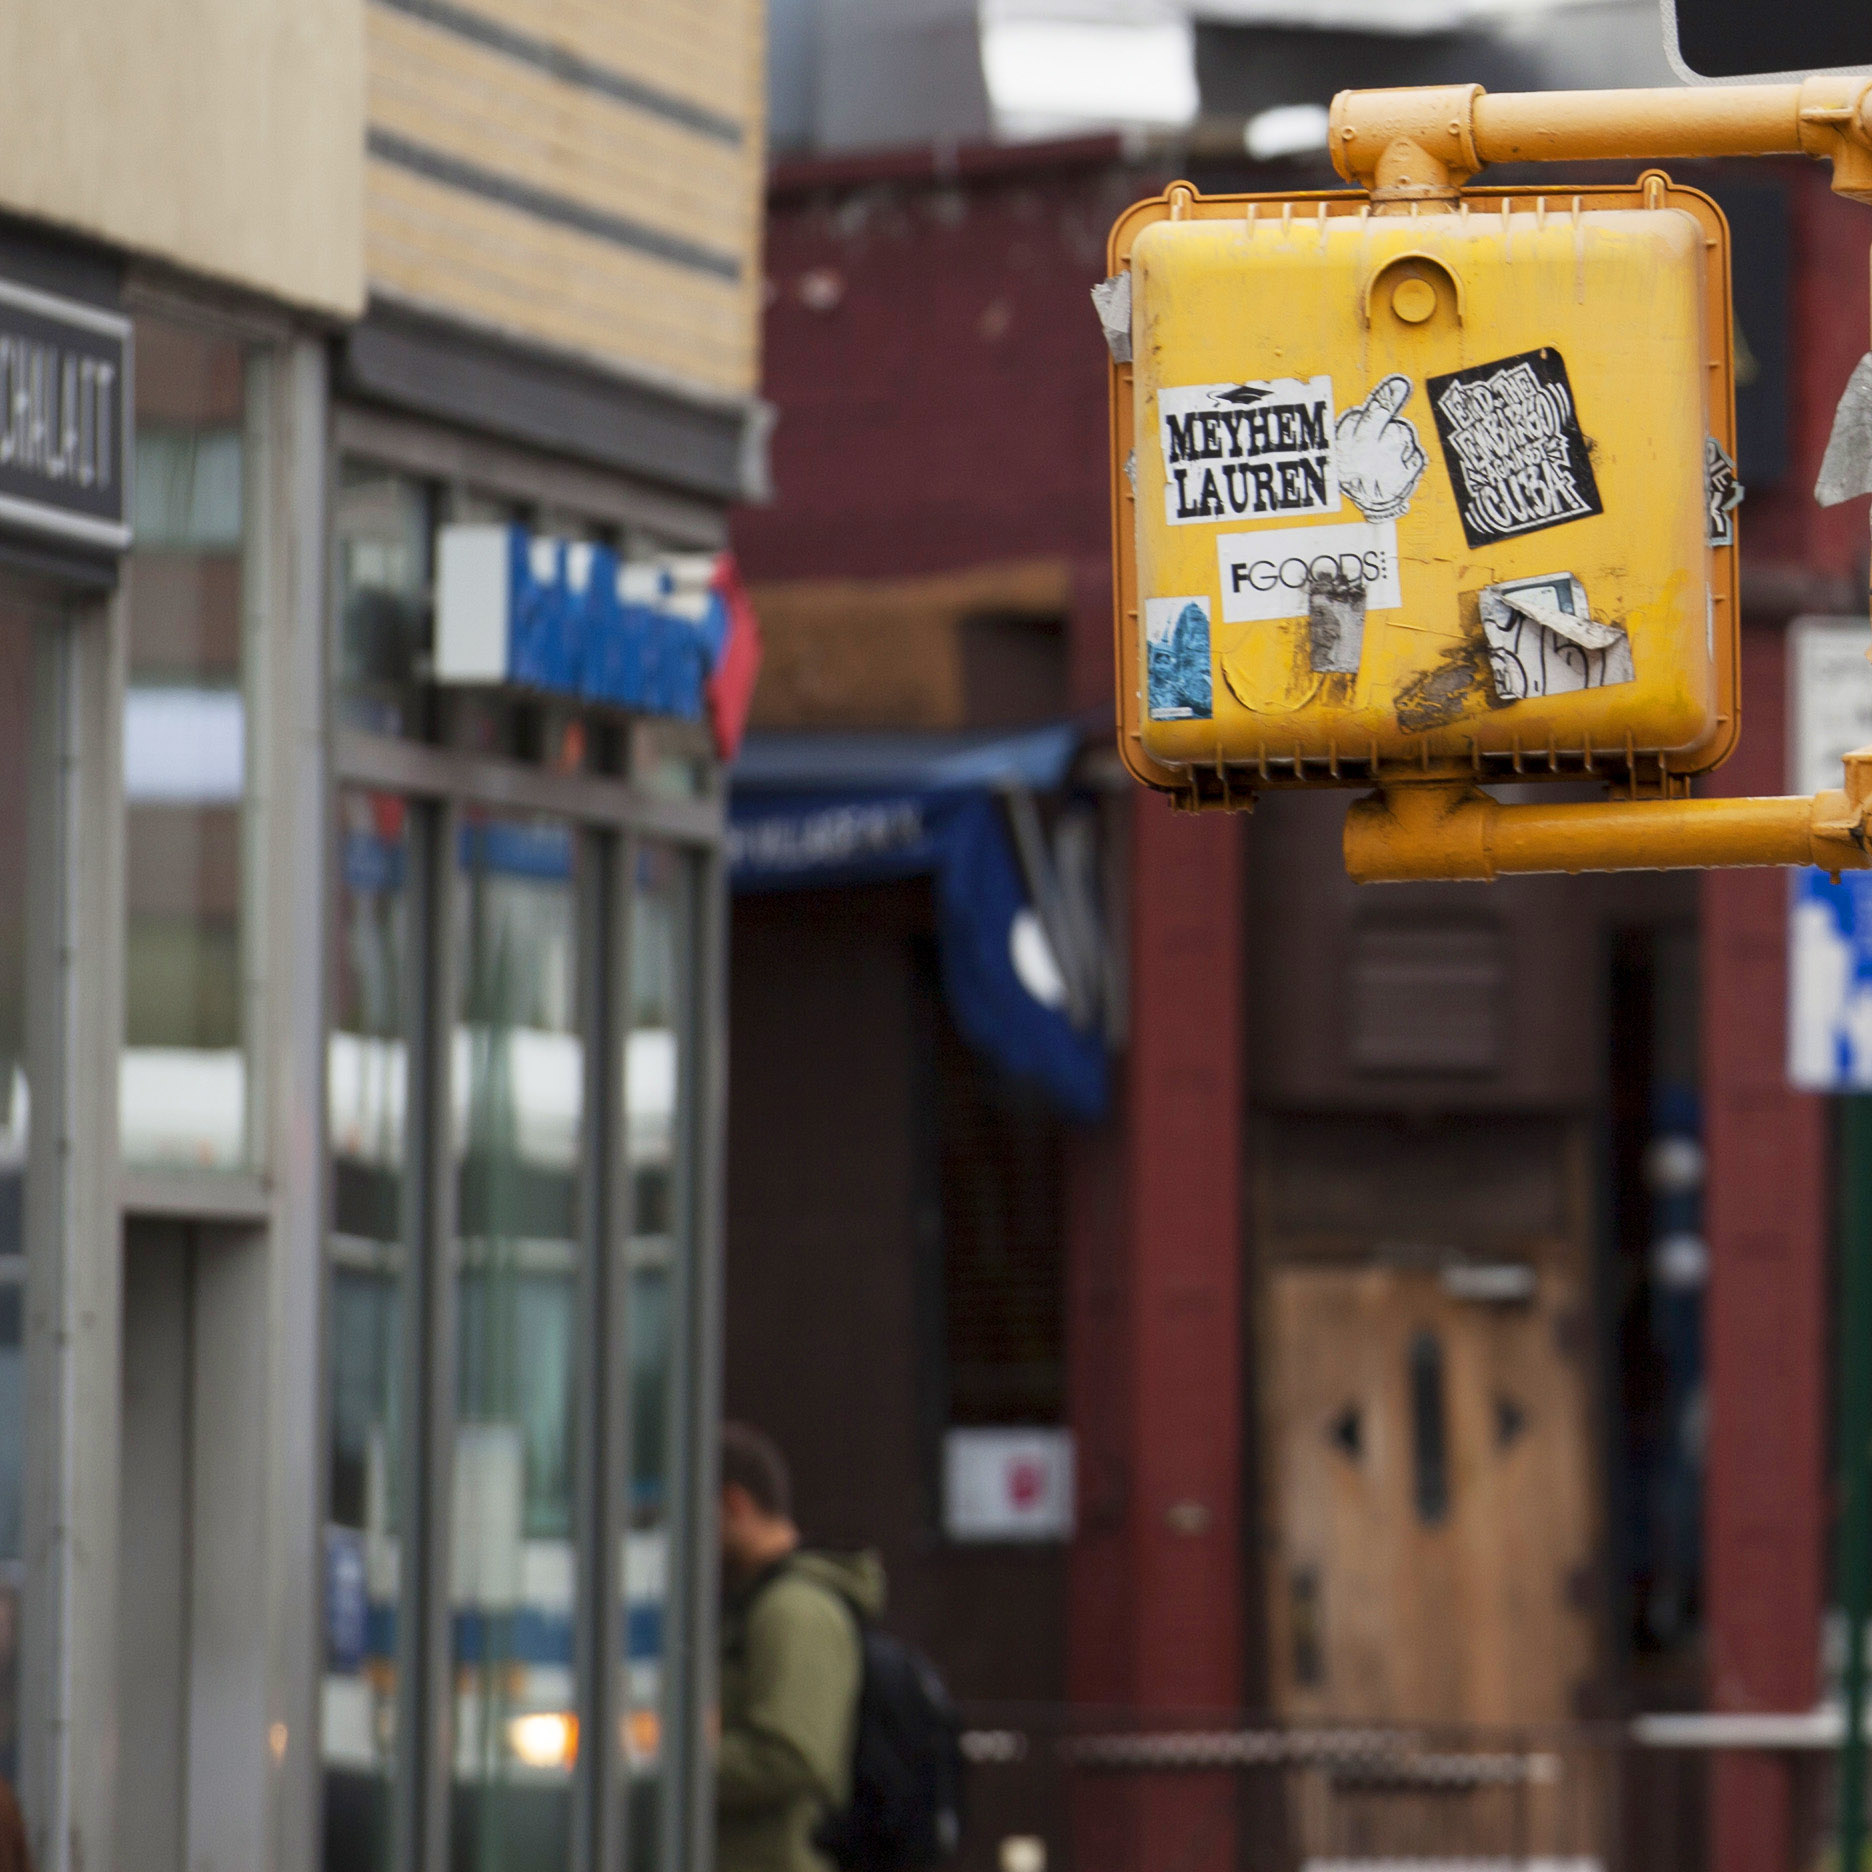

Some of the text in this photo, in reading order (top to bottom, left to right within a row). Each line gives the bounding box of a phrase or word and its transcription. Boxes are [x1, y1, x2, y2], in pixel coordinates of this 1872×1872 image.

[1492, 370, 1538, 406] THE
[1165, 400, 1330, 464] MEYHEM
[1173, 455, 1328, 519] LAUREN
